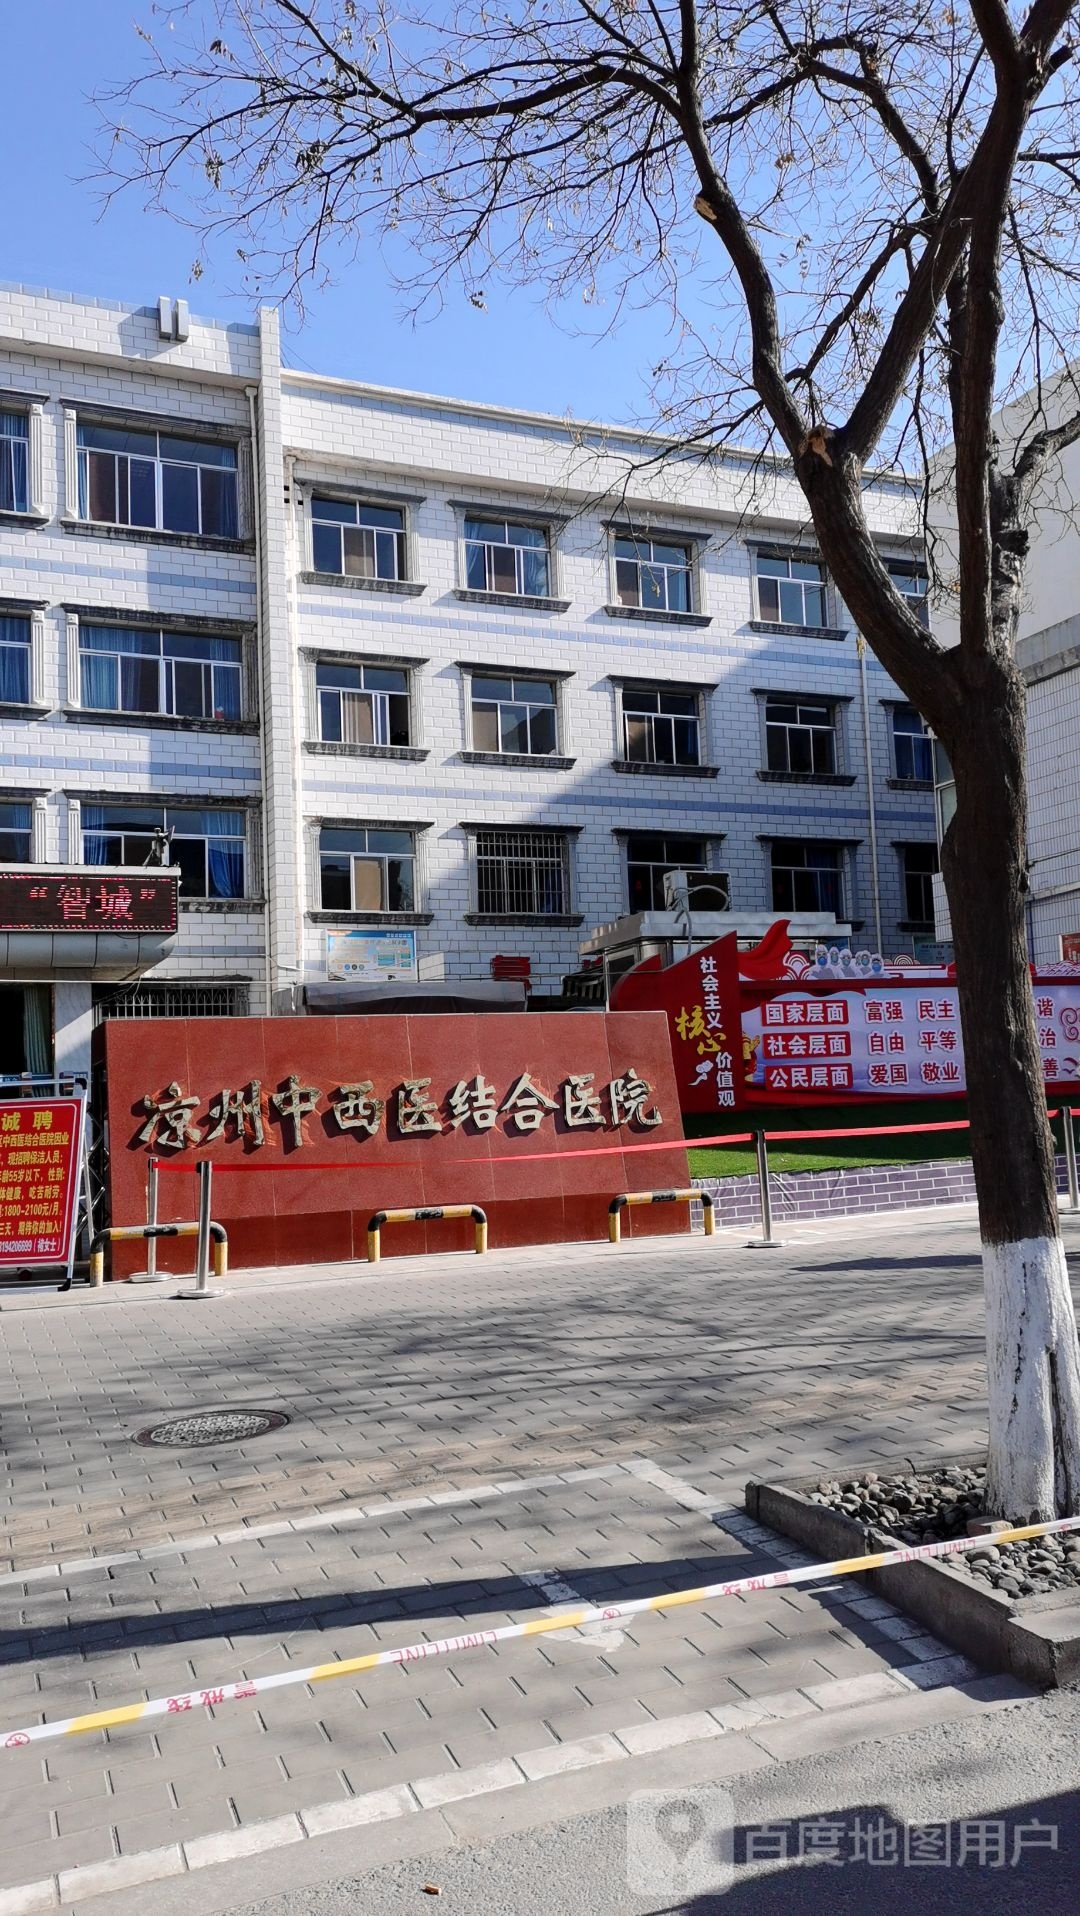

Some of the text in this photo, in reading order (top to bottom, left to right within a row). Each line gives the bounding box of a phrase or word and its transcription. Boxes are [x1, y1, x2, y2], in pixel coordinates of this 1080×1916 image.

[700, 956, 724, 1030] 社会主义
[765, 998, 1054, 1025] 国家层面 富强 民主 谐
[675, 1005, 727, 1056] 核心
[767, 1028, 1056, 1056] 社会层面 自由 平等 治
[716, 1051, 736, 1107] 价值观
[769, 1058, 1059, 1088] 公民层面 爱国 敬业 善
[139, 1067, 663, 1149] 凉州中西医结合医院
